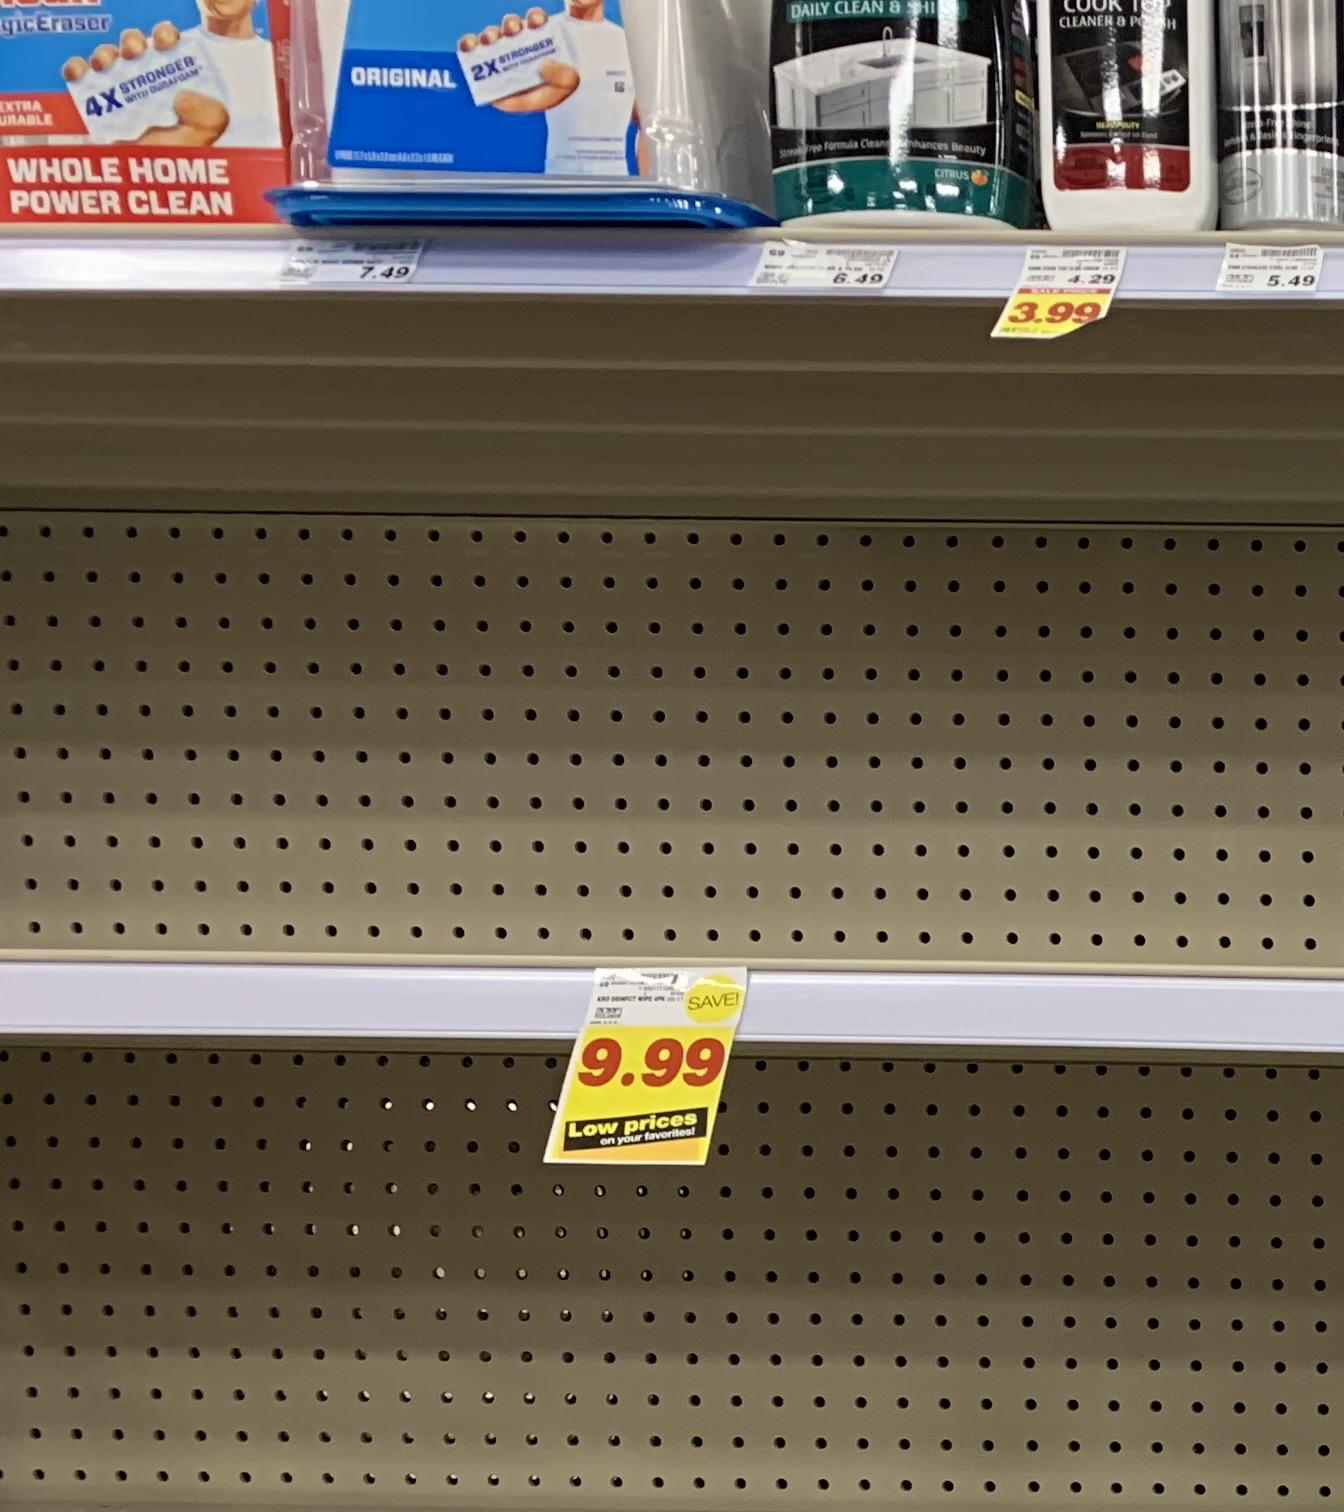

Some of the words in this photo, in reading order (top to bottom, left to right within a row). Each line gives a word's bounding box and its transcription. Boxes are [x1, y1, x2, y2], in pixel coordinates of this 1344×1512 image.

[791, 1, 829, 19] DAILY
[834, 0, 884, 15] CLEAN
[1058, 15, 1113, 28] CLEANER
[350, 65, 458, 89] ORIGINAL
[470, 58, 501, 82] 2X
[86, 88, 124, 117] 4X
[119, 56, 196, 95] STRONGER
[7, 157, 122, 184] WHOLE
[128, 157, 230, 184] HOME
[9, 190, 121, 215] POWER
[127, 190, 234, 216] CLEAN
[359, 265, 411, 280] 7.49
[832, 272, 884, 285] 6.49
[1067, 273, 1117, 285] 4.29
[1266, 274, 1316, 287] 5.49
[1007, 301, 1103, 325] 3.99
[687, 991, 740, 1011] SAVE!
[577, 1037, 726, 1088] 9.99
[568, 1122, 618, 1139] Low
[624, 1112, 698, 1136] prices
[600, 1136, 615, 1146] on
[617, 1133, 643, 1147] your
[644, 1126, 696, 1142] favorites!
